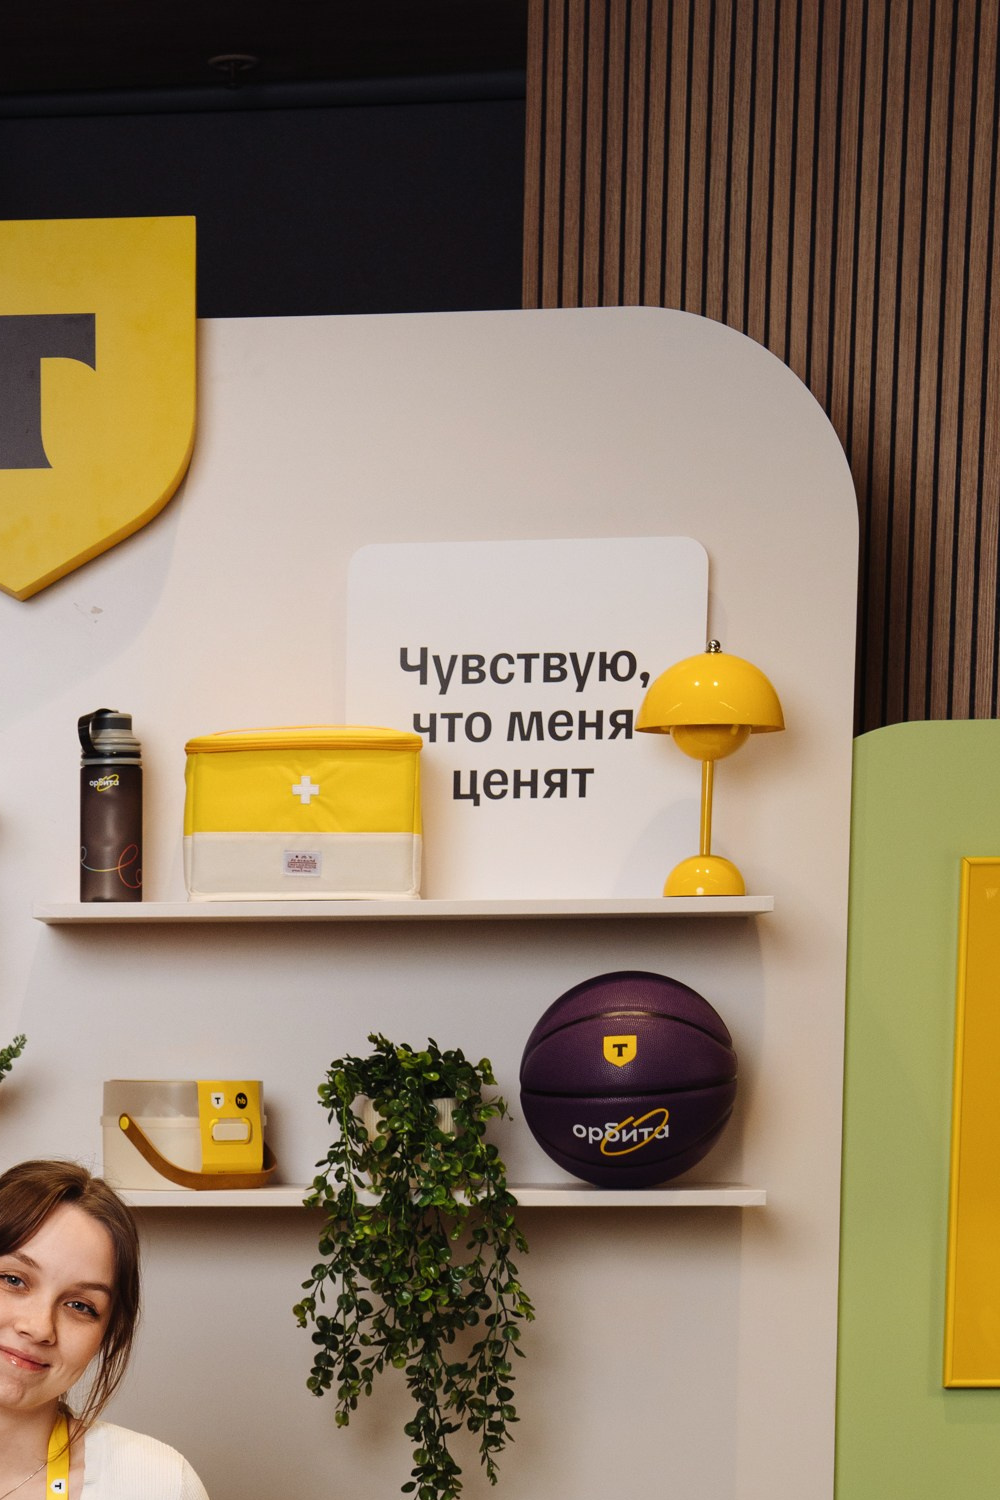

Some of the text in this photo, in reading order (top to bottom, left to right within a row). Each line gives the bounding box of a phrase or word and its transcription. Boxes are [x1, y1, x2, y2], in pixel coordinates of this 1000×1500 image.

[400, 647, 650, 695] Чувствую,
[413, 709, 633, 743] что меня
[453, 768, 594, 806] ценят
[572, 1121, 670, 1146] орбита
